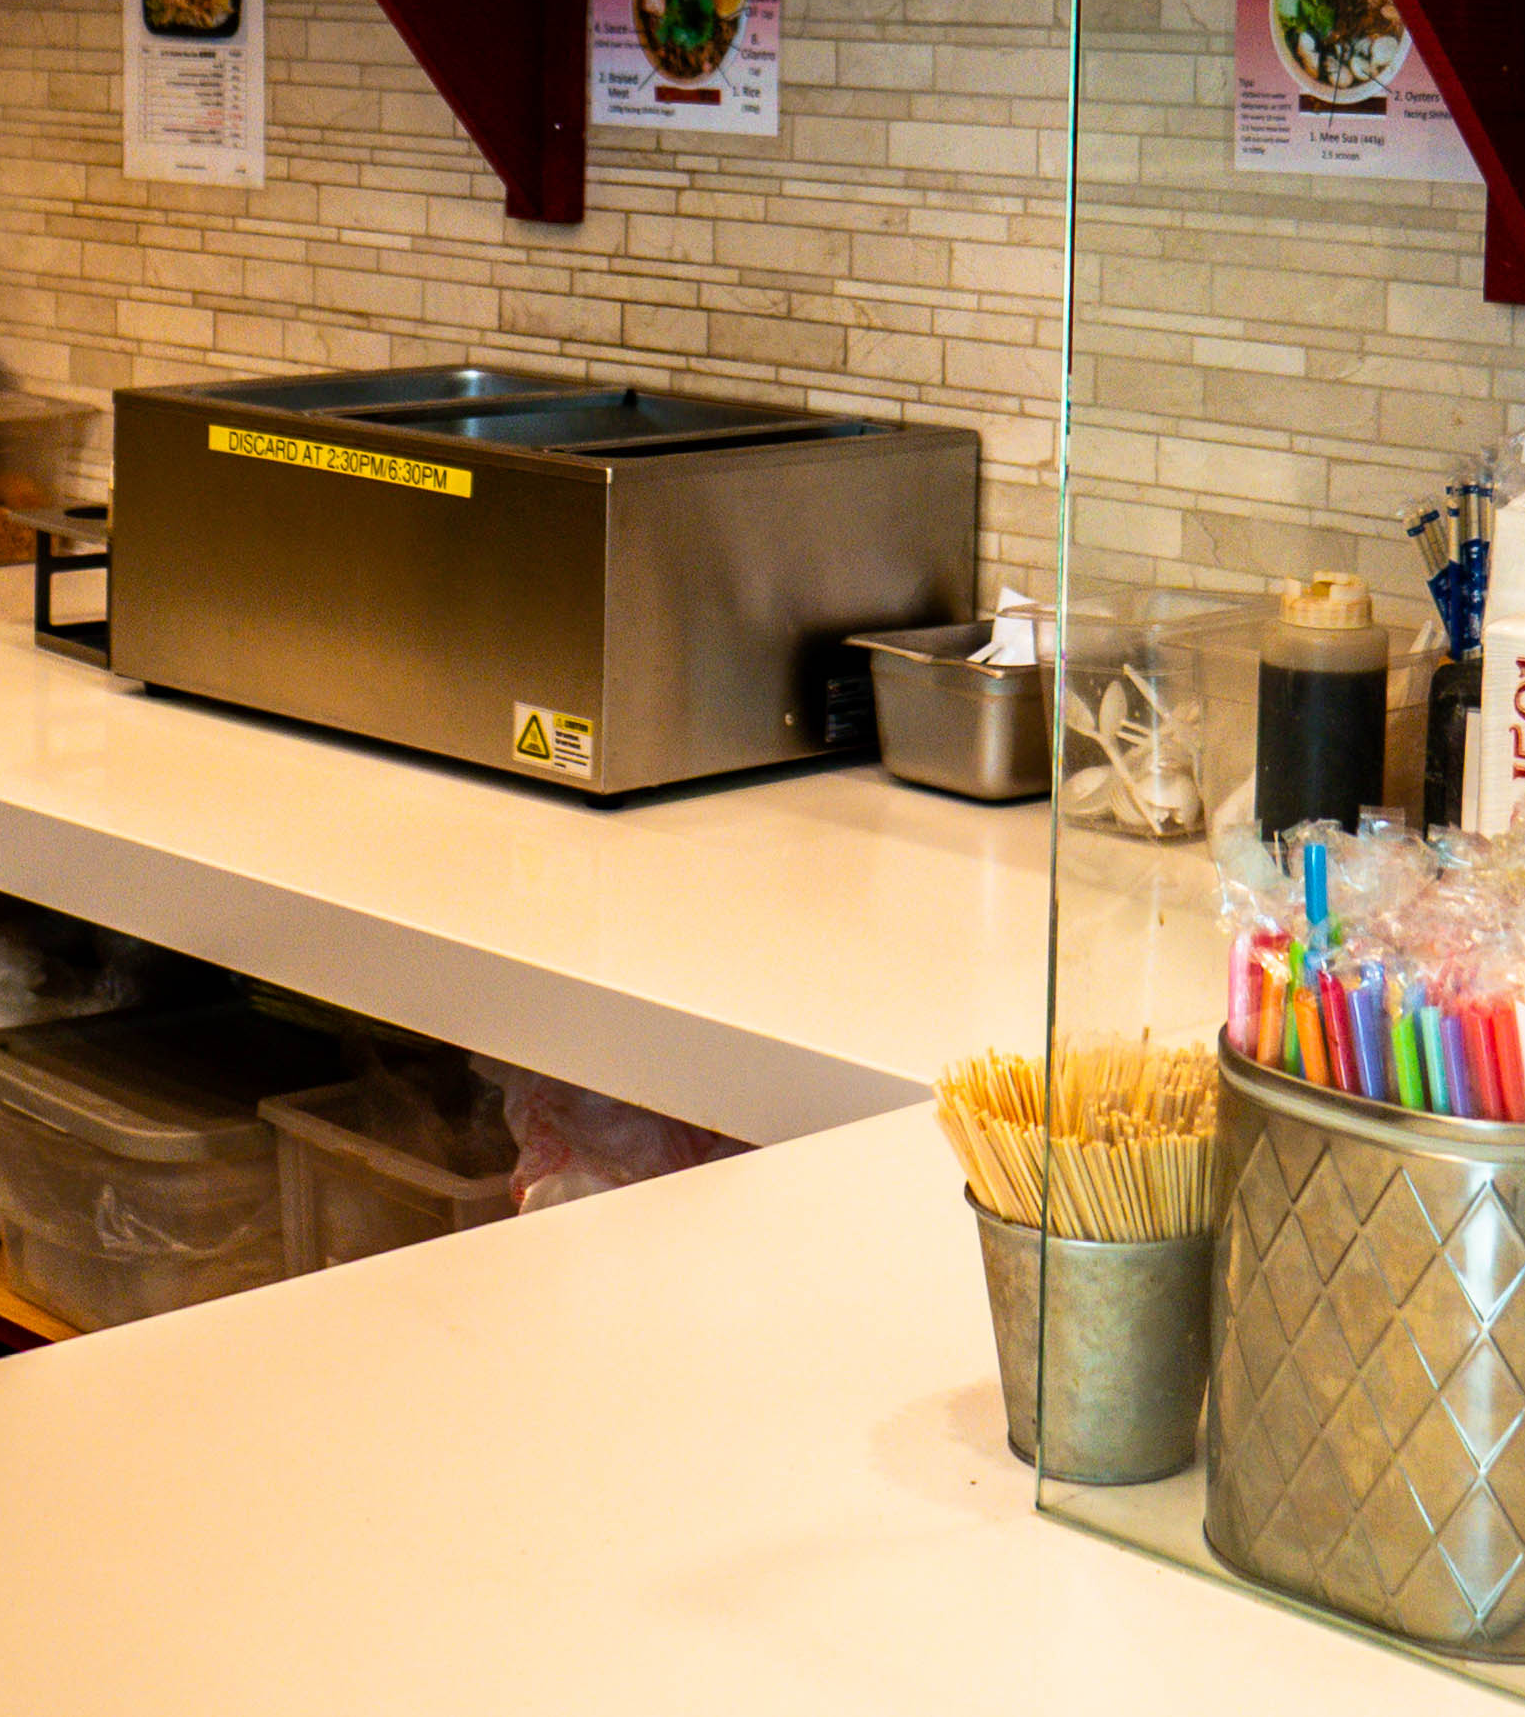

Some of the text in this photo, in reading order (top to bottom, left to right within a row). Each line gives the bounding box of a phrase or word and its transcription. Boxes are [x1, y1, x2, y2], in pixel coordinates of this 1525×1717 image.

[228, 431, 448, 491] DISCARD AT 2:30PM/6:30PM
